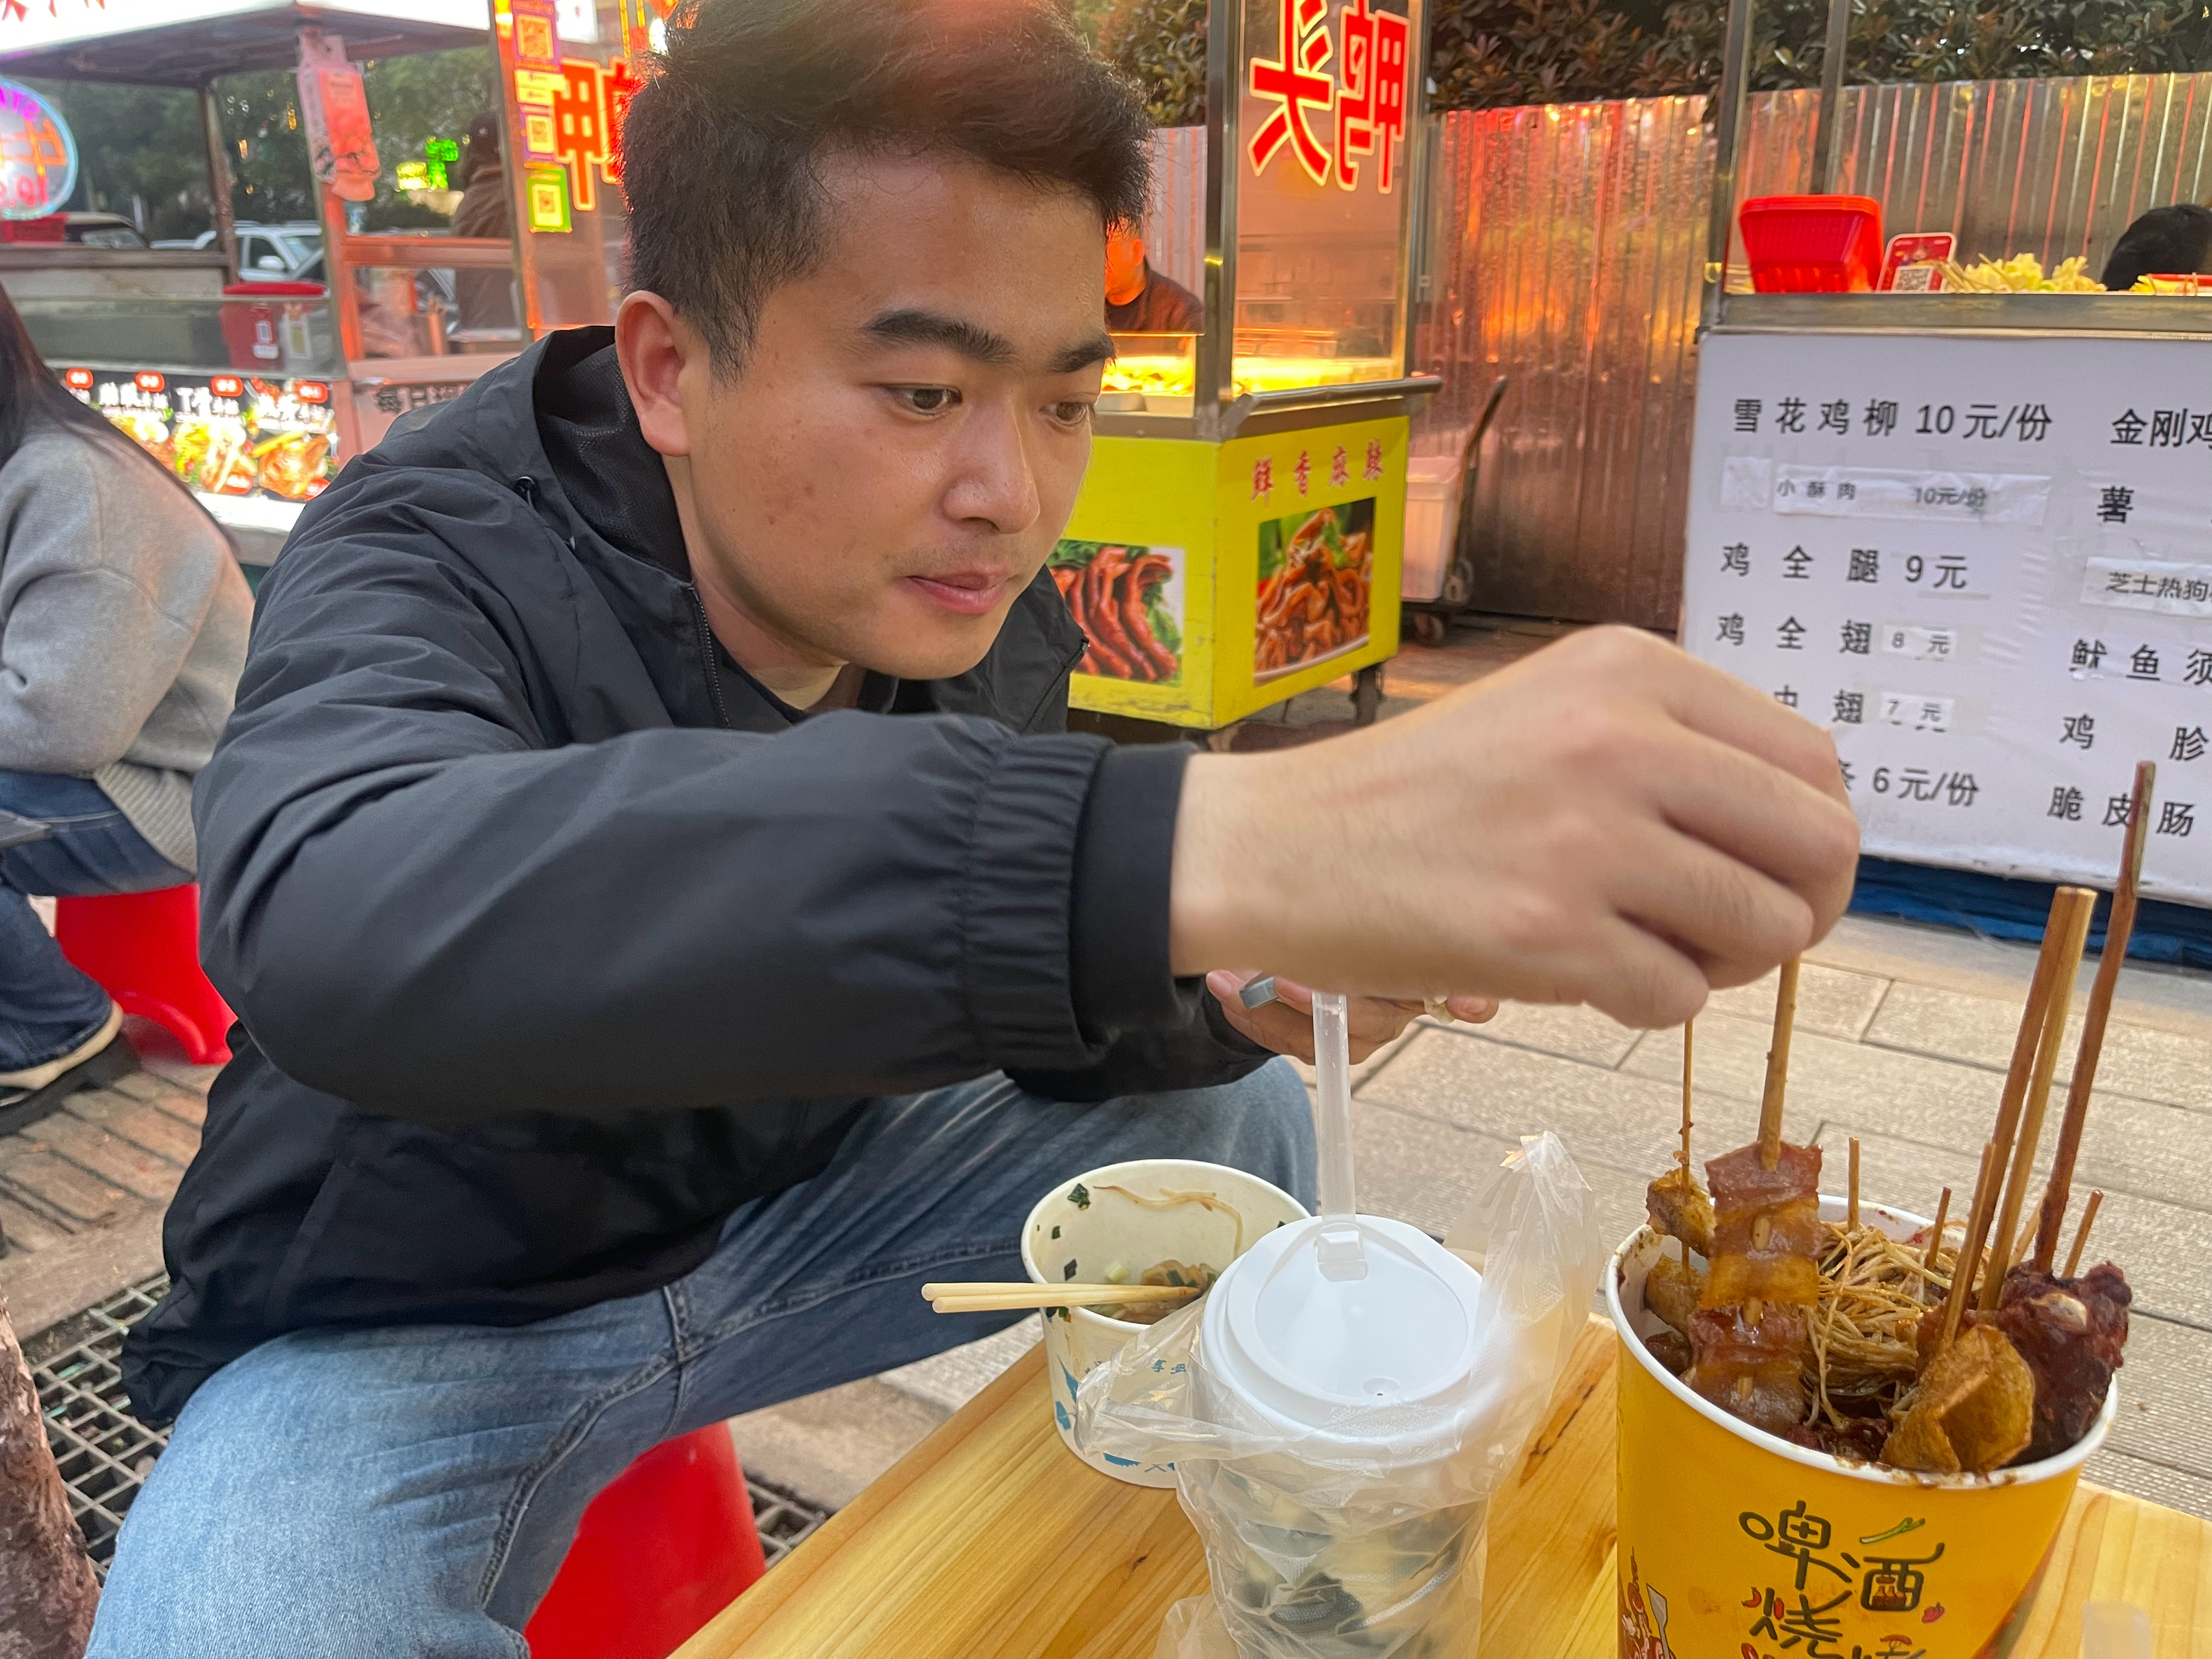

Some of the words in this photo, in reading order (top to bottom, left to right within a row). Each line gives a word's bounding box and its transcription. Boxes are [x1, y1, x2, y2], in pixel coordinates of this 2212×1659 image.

[1734, 397, 1899, 436] 雪花鸡柳
[2109, 408, 2212, 449] 金刚鸡
[1777, 478, 1858, 501] 小酥肉
[2096, 486, 2135, 523] 薯
[1720, 542, 1880, 583] 鸡全腿
[1905, 555, 1968, 589] 9元
[2105, 571, 2212, 602] 芝士热狗
[1716, 613, 1873, 654] 鸡全翅
[1892, 631, 1950, 654] 8元
[2068, 638, 2212, 686] 鱿鱼须
[1887, 698, 1941, 722] 7元
[2059, 713, 2209, 761] 鸡胗
[2047, 786, 2194, 837] 脆皮肠
[1739, 1499, 1945, 1611] 啤酒
